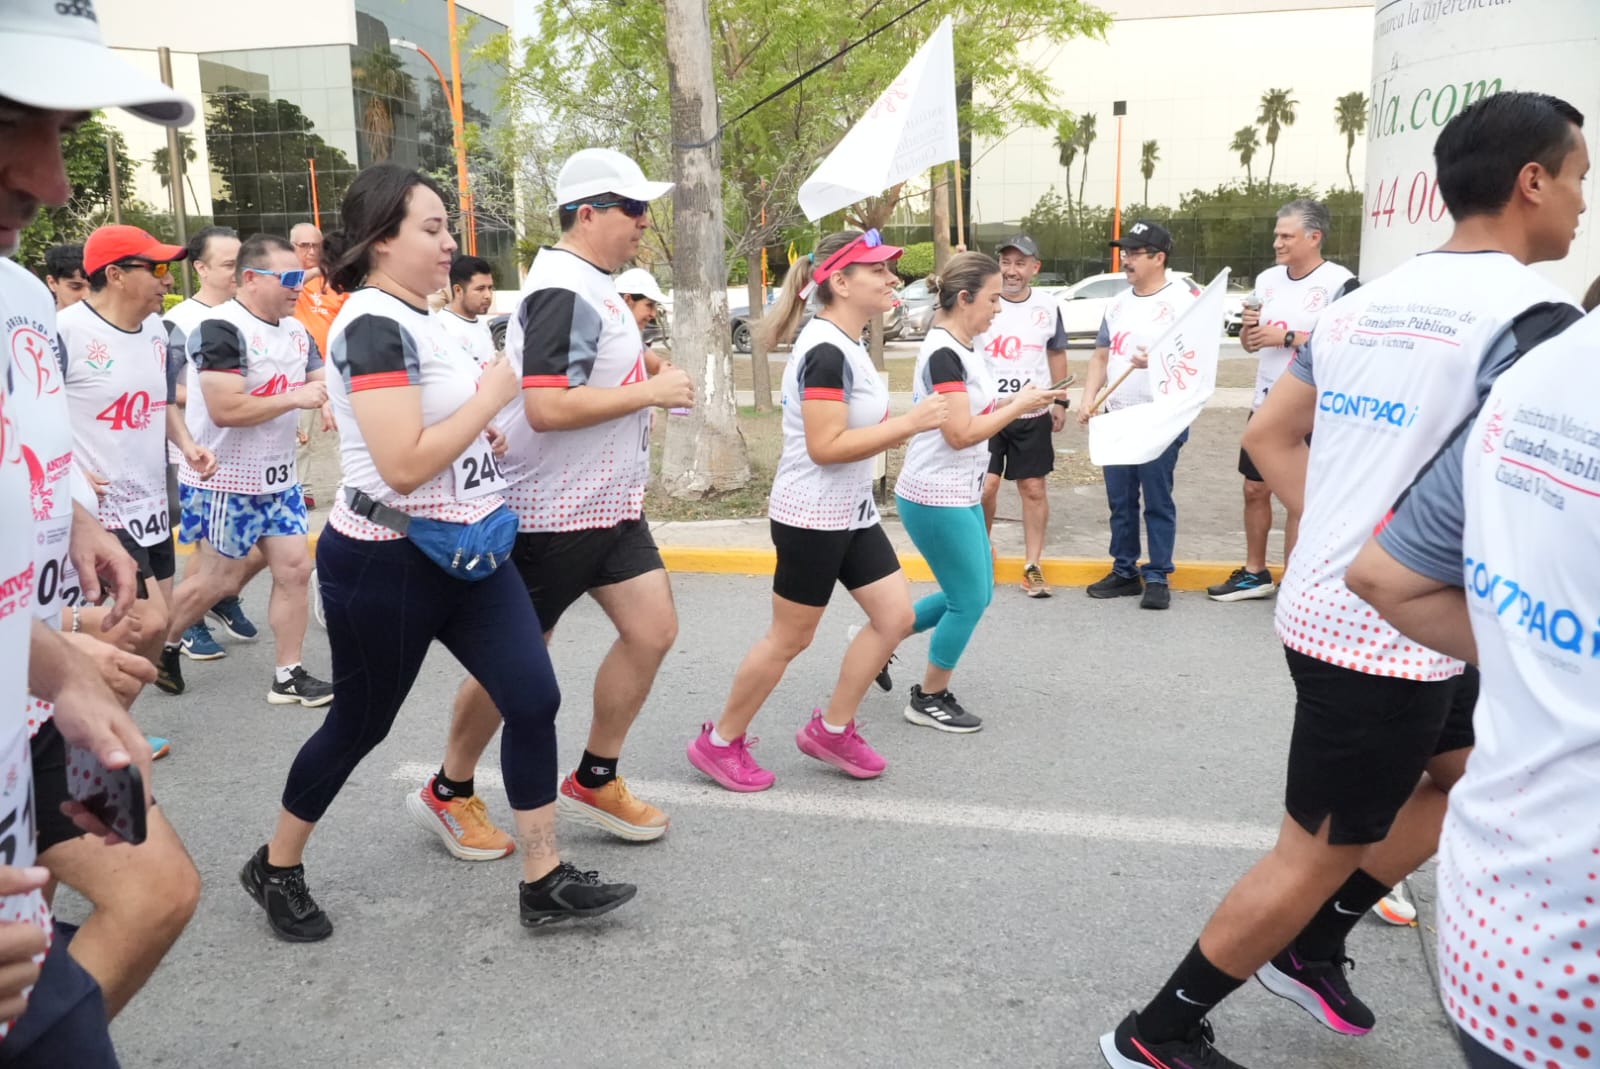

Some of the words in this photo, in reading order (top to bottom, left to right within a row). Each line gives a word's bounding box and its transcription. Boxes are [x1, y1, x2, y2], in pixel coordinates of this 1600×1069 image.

[1407, 2, 1419, 25] la
[1407, 316, 1458, 337] Públicos
[1459, 310, 1477, 325] de
[985, 334, 1022, 360] 40
[95, 390, 151, 431] 40
[265, 461, 294, 486] 03
[129, 510, 168, 540] 040
